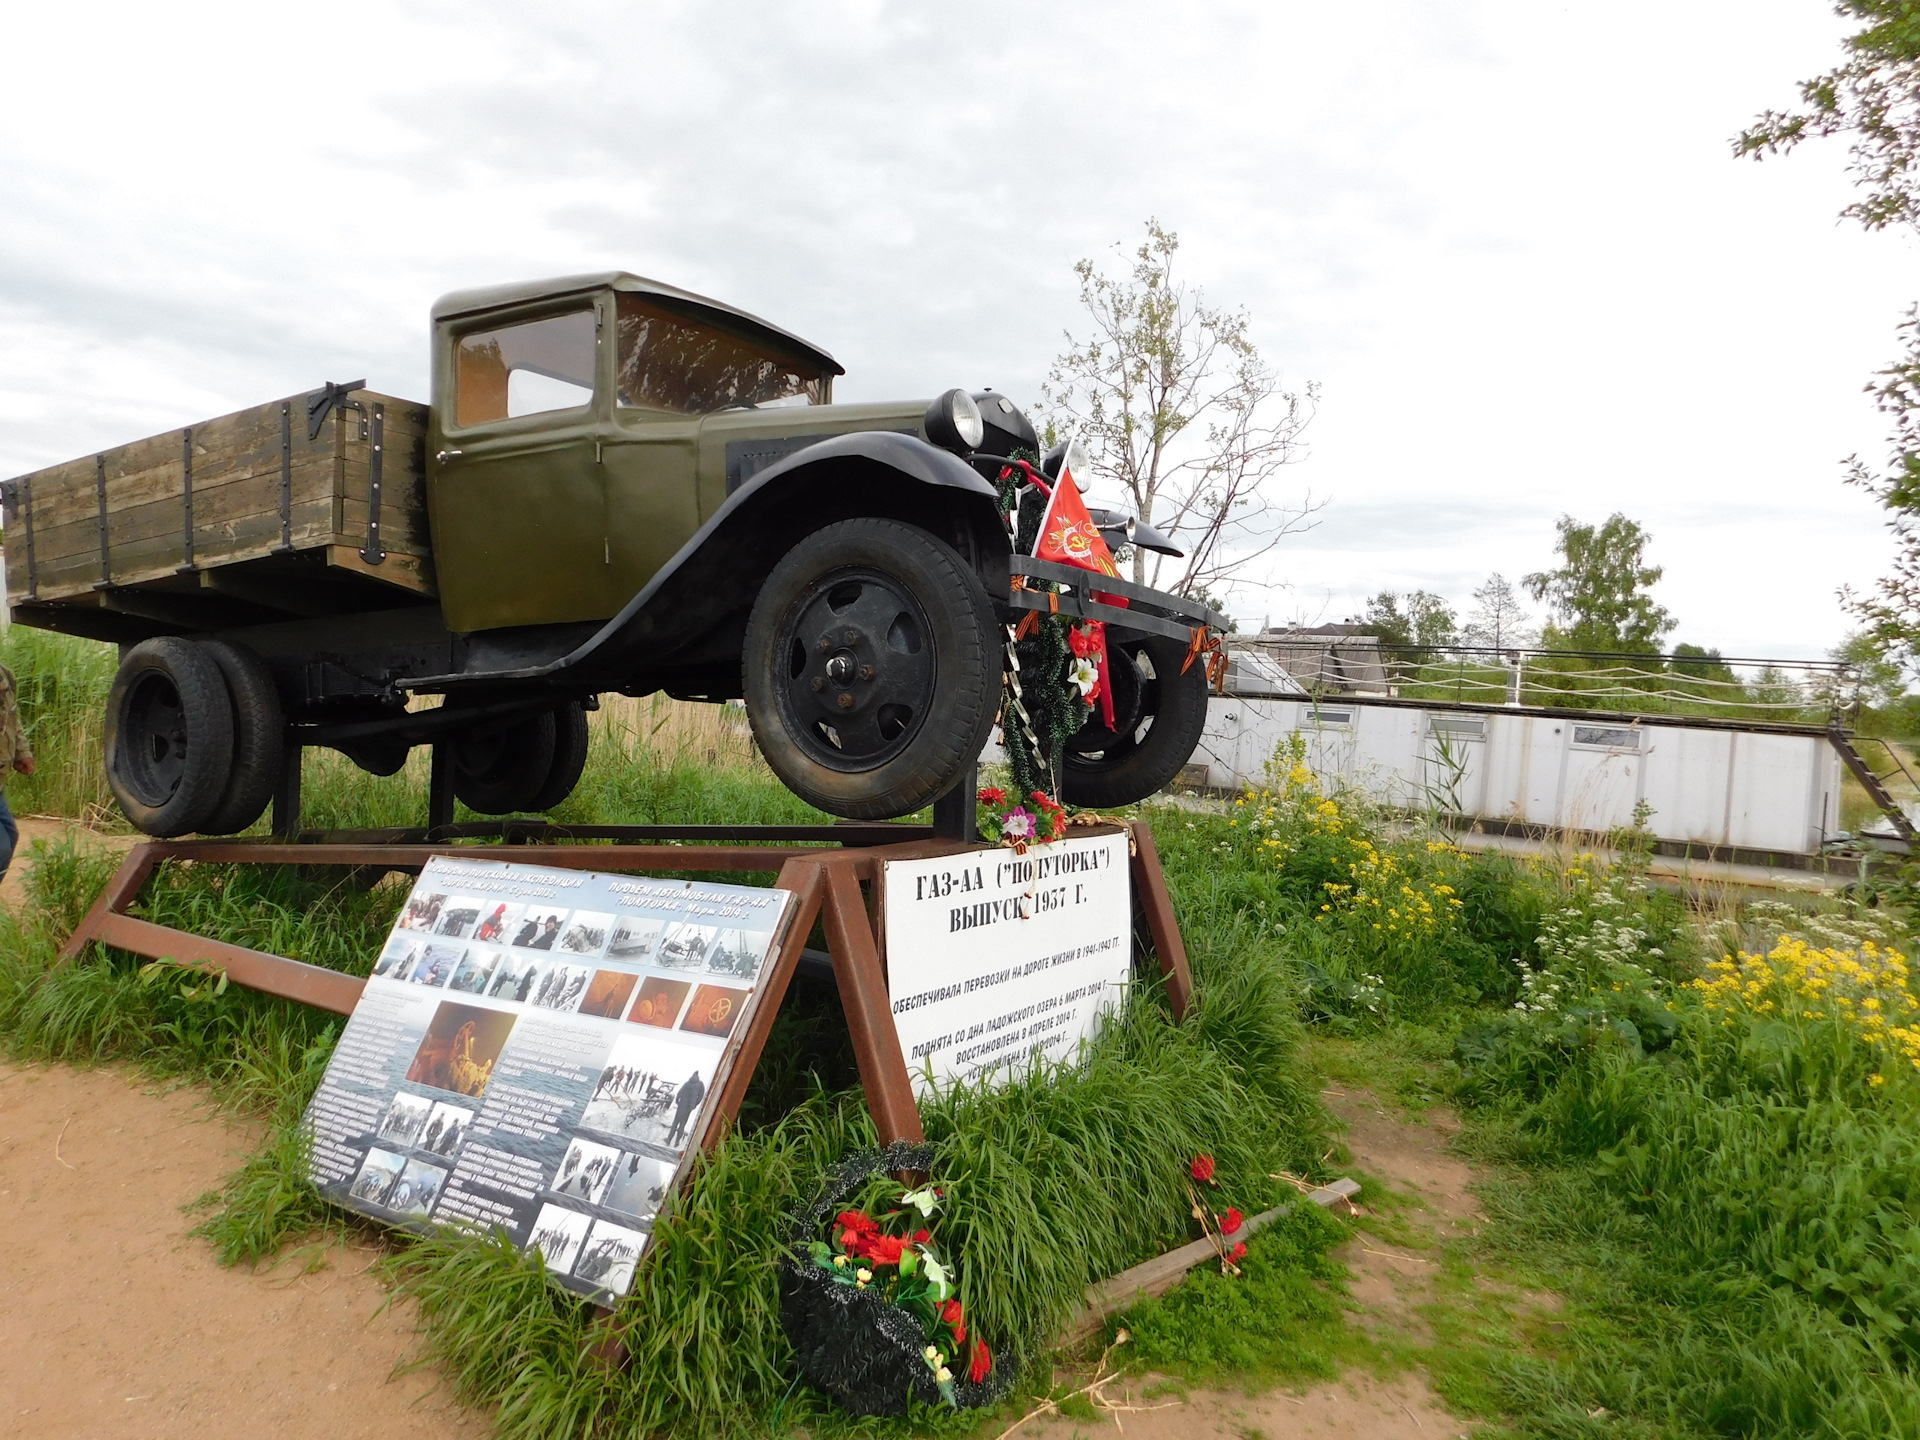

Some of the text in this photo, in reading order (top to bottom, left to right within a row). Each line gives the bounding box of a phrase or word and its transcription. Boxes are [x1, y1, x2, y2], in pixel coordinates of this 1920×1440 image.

[520, 873, 584, 889] ЭКСПЕДИЦИЯ
[533, 887, 551, 898] 2013
[608, 882, 770, 909] ПОДЪЕМ АВТОМОБИЛЯ ГАЗ-АА
[916, 866, 984, 901] ГАЗ-АА
[685, 903, 717, 919] Март
[719, 906, 741, 918] 2014
[949, 883, 1087, 933] ВЫПУСК 1937 Г.
[893, 983, 962, 1015] ОБЕСПЕЧИВАЛА
[964, 968, 1010, 994] ПЕРЕВОЗКИ
[1011, 965, 1022, 979] НА
[1023, 957, 1050, 978] ДОРОГЕ
[1050, 949, 1076, 967] ЖИЗНИ
[1076, 948, 1081, 959] В
[1082, 939, 1111, 958] 1941-1943
[911, 1033, 952, 1061] ПОДНЯТА
[955, 1029, 965, 1044] СО
[966, 1022, 984, 1042] ДНА
[986, 1005, 1035, 1034] ЛАДОЖСКОГО
[1036, 996, 1057, 1014] ОЗЕРА
[1059, 995, 1063, 1007] 6
[1064, 986, 1086, 1004] МАРТА
[1087, 980, 1101, 996] 2014
[956, 1031, 1019, 1065] ВОССТАНОВЛЕНА
[1022, 1028, 1027, 1039] В
[1028, 1016, 1054, 1038] АПРЕЛЕ
[1055, 1012, 1070, 1027] 2014
[1045, 1036, 1060, 1049] 2014
